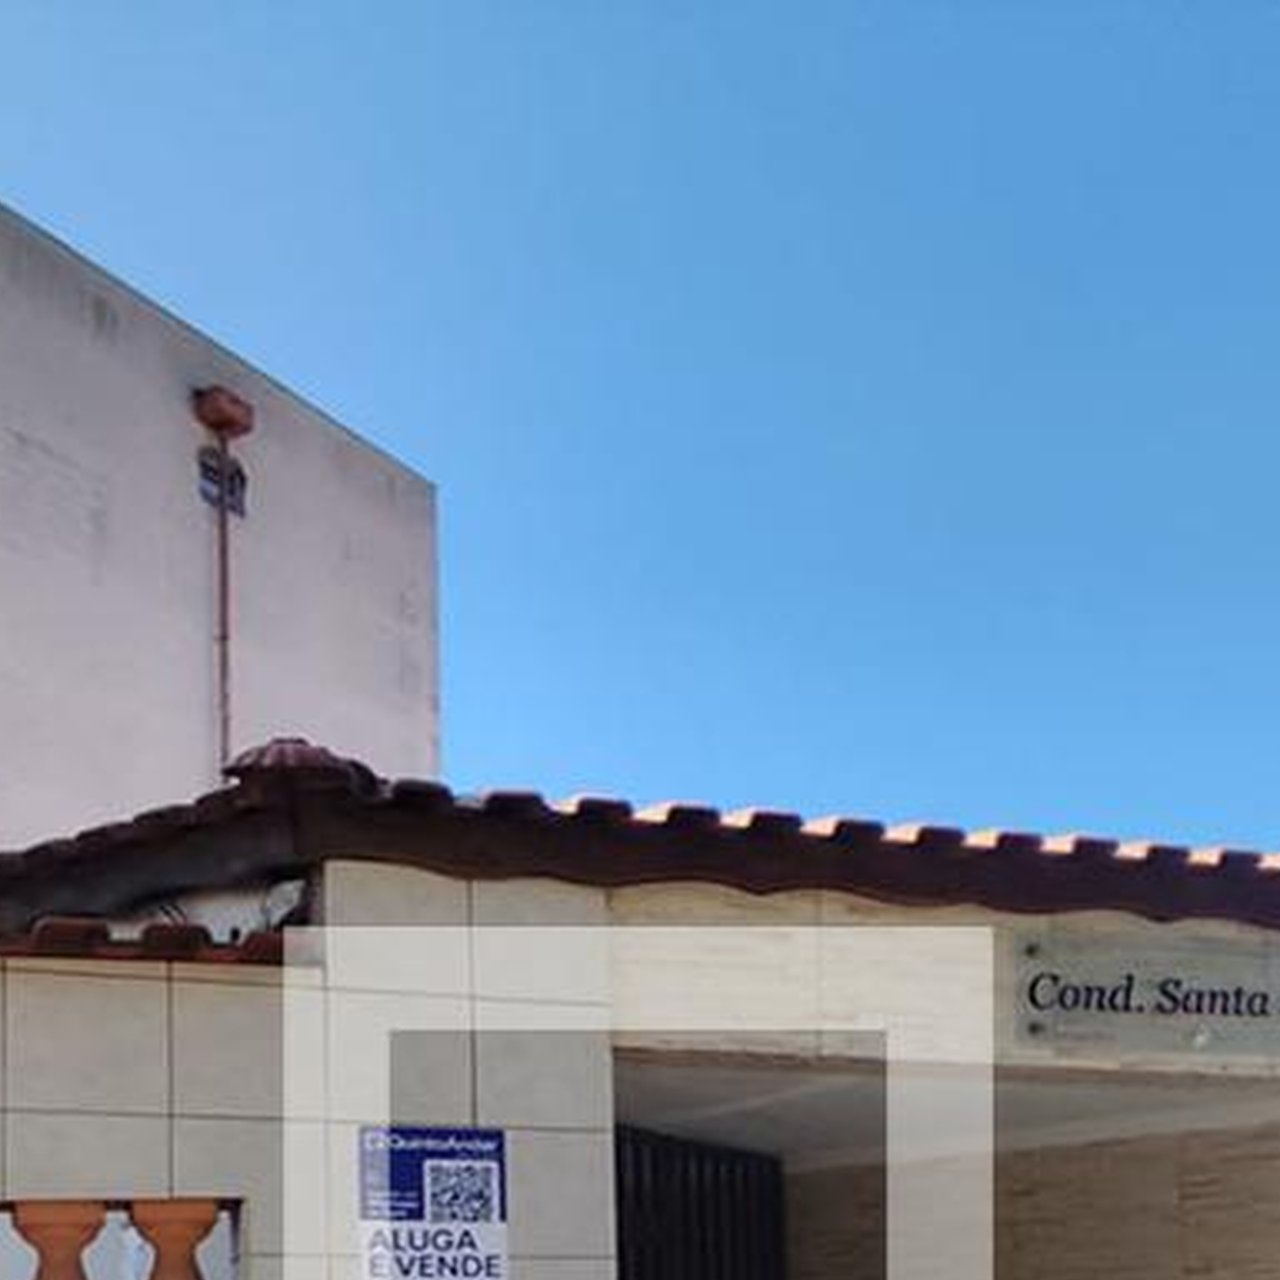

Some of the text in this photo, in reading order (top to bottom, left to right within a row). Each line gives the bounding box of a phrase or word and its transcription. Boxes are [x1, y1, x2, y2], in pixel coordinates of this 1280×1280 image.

[1027, 971, 1145, 1013] Cond.
[1155, 978, 1270, 1017] Santa
[369, 1229, 478, 1251] ALUGA
[371, 1254, 502, 1278] E VENDE
